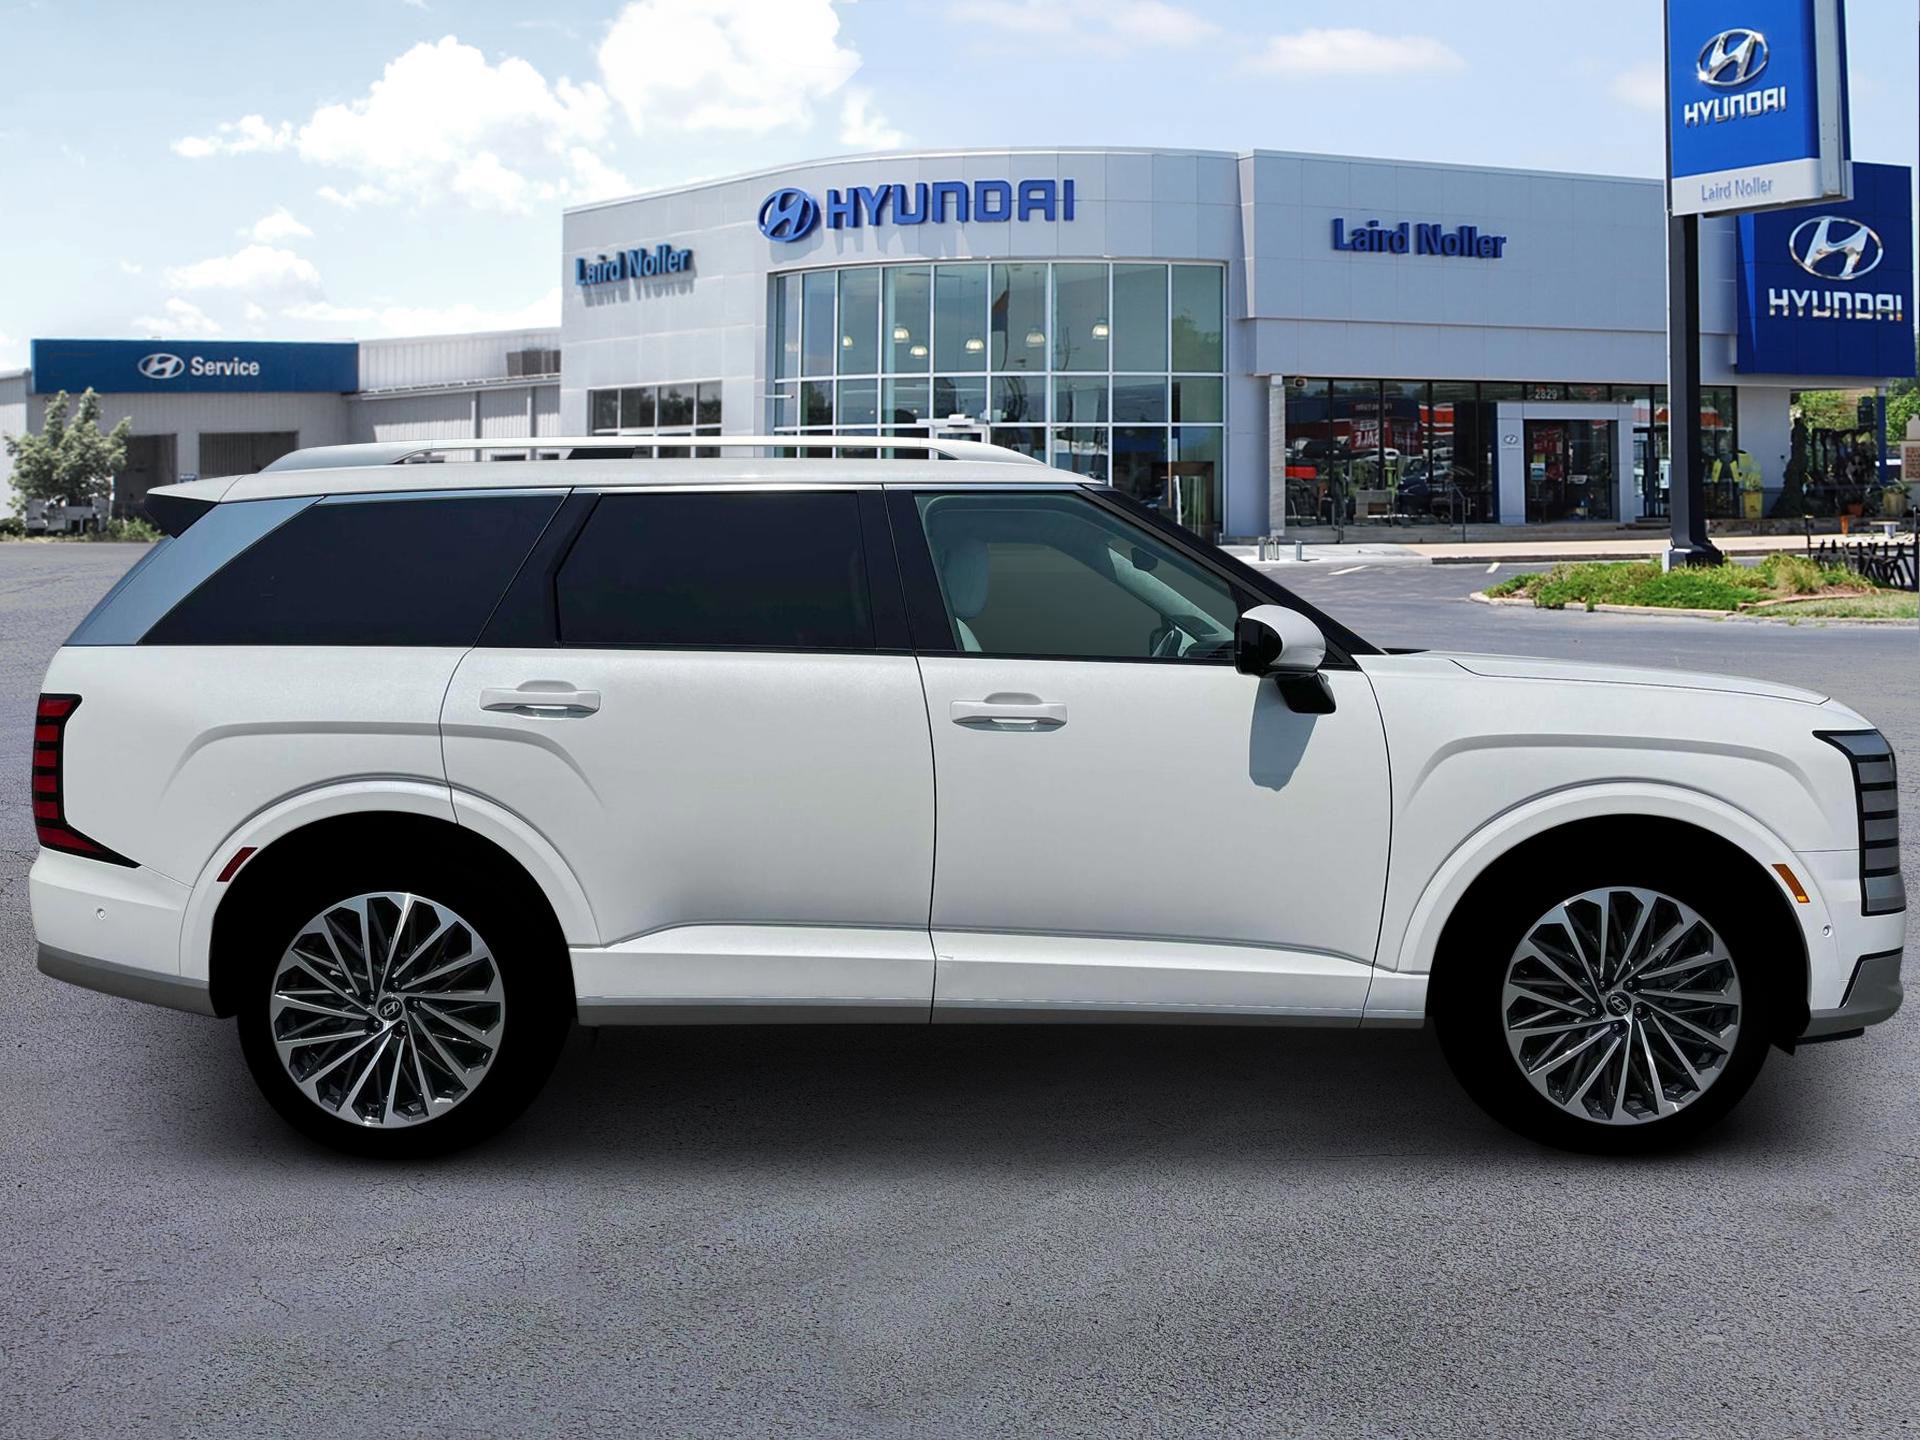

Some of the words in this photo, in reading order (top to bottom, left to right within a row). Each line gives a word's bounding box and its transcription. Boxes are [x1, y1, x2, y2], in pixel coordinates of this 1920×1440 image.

[1684, 86, 1787, 127] HYUNDAI
[827, 179, 1074, 229] HYUNDAI
[1701, 180, 1731, 201] Laird
[1735, 177, 1773, 198] Noller
[1332, 217, 1410, 254] Laird
[1415, 222, 1507, 258] Noller
[576, 251, 626, 286] Laird
[627, 243, 693, 278] Noller
[1768, 288, 1903, 321] HYUNDAI
[190, 356, 260, 376] Service
[1534, 388, 1558, 400] 2829
